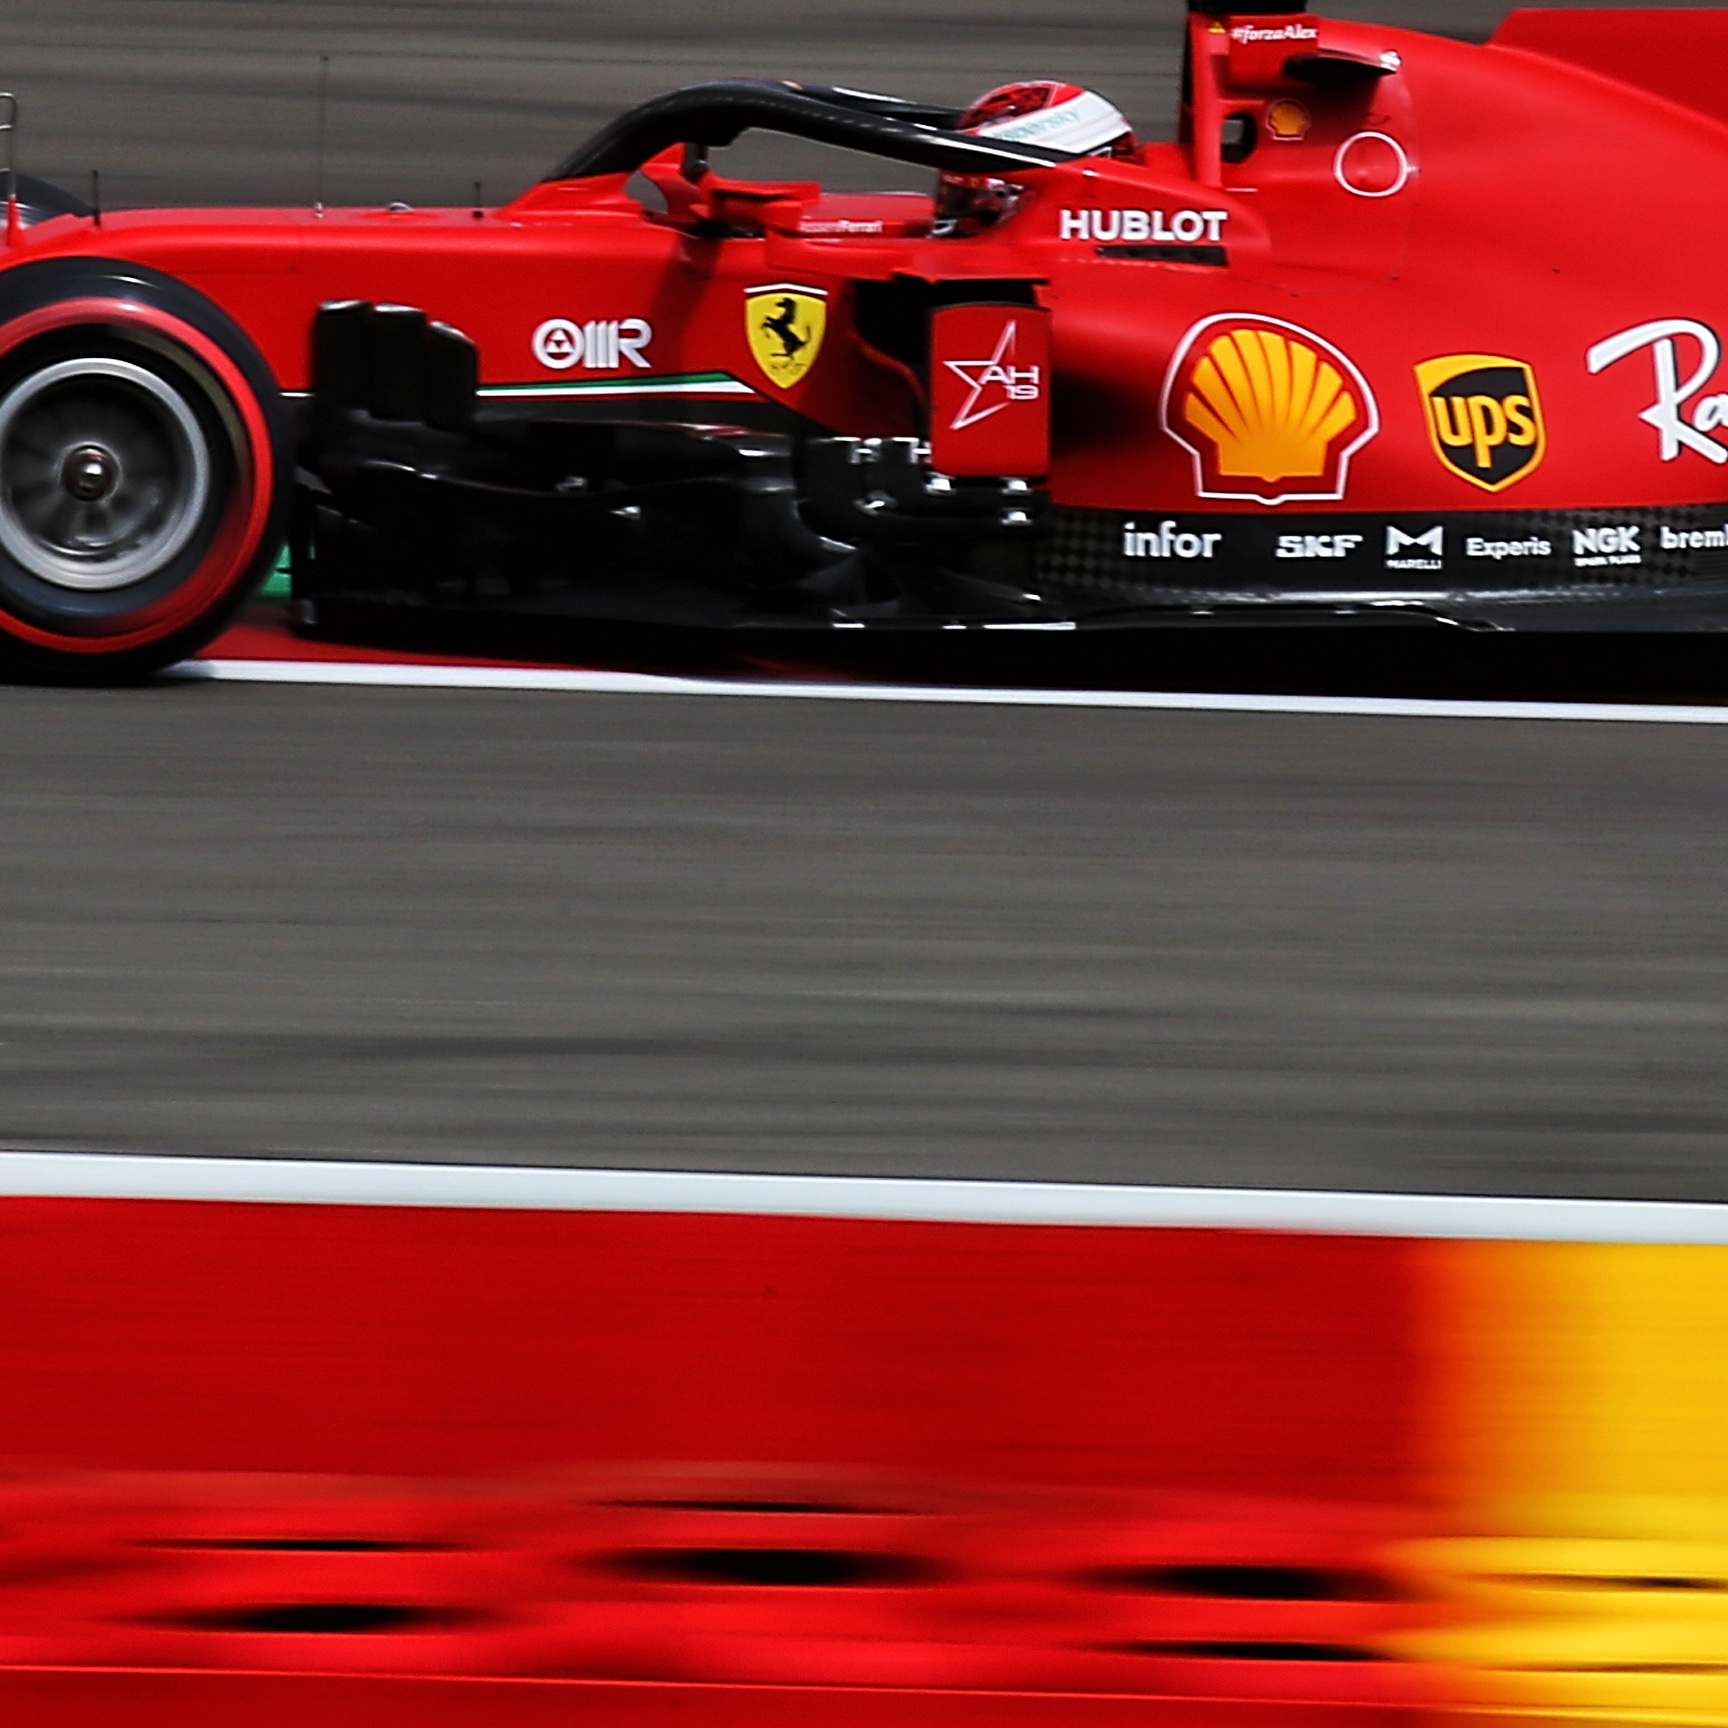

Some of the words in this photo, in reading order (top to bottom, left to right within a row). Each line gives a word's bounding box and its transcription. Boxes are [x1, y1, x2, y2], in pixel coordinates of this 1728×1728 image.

[1060, 209, 1228, 242] HUBLOT
[979, 365, 1040, 385] AH
[1005, 384, 1040, 400] 19
[1430, 394, 1537, 469] ups
[1124, 520, 1222, 558] infor
[1274, 534, 1364, 558] SKF
[1465, 535, 1552, 560] Experis
[1572, 525, 1641, 555] NGK
[1386, 558, 1443, 570] MARELLI
